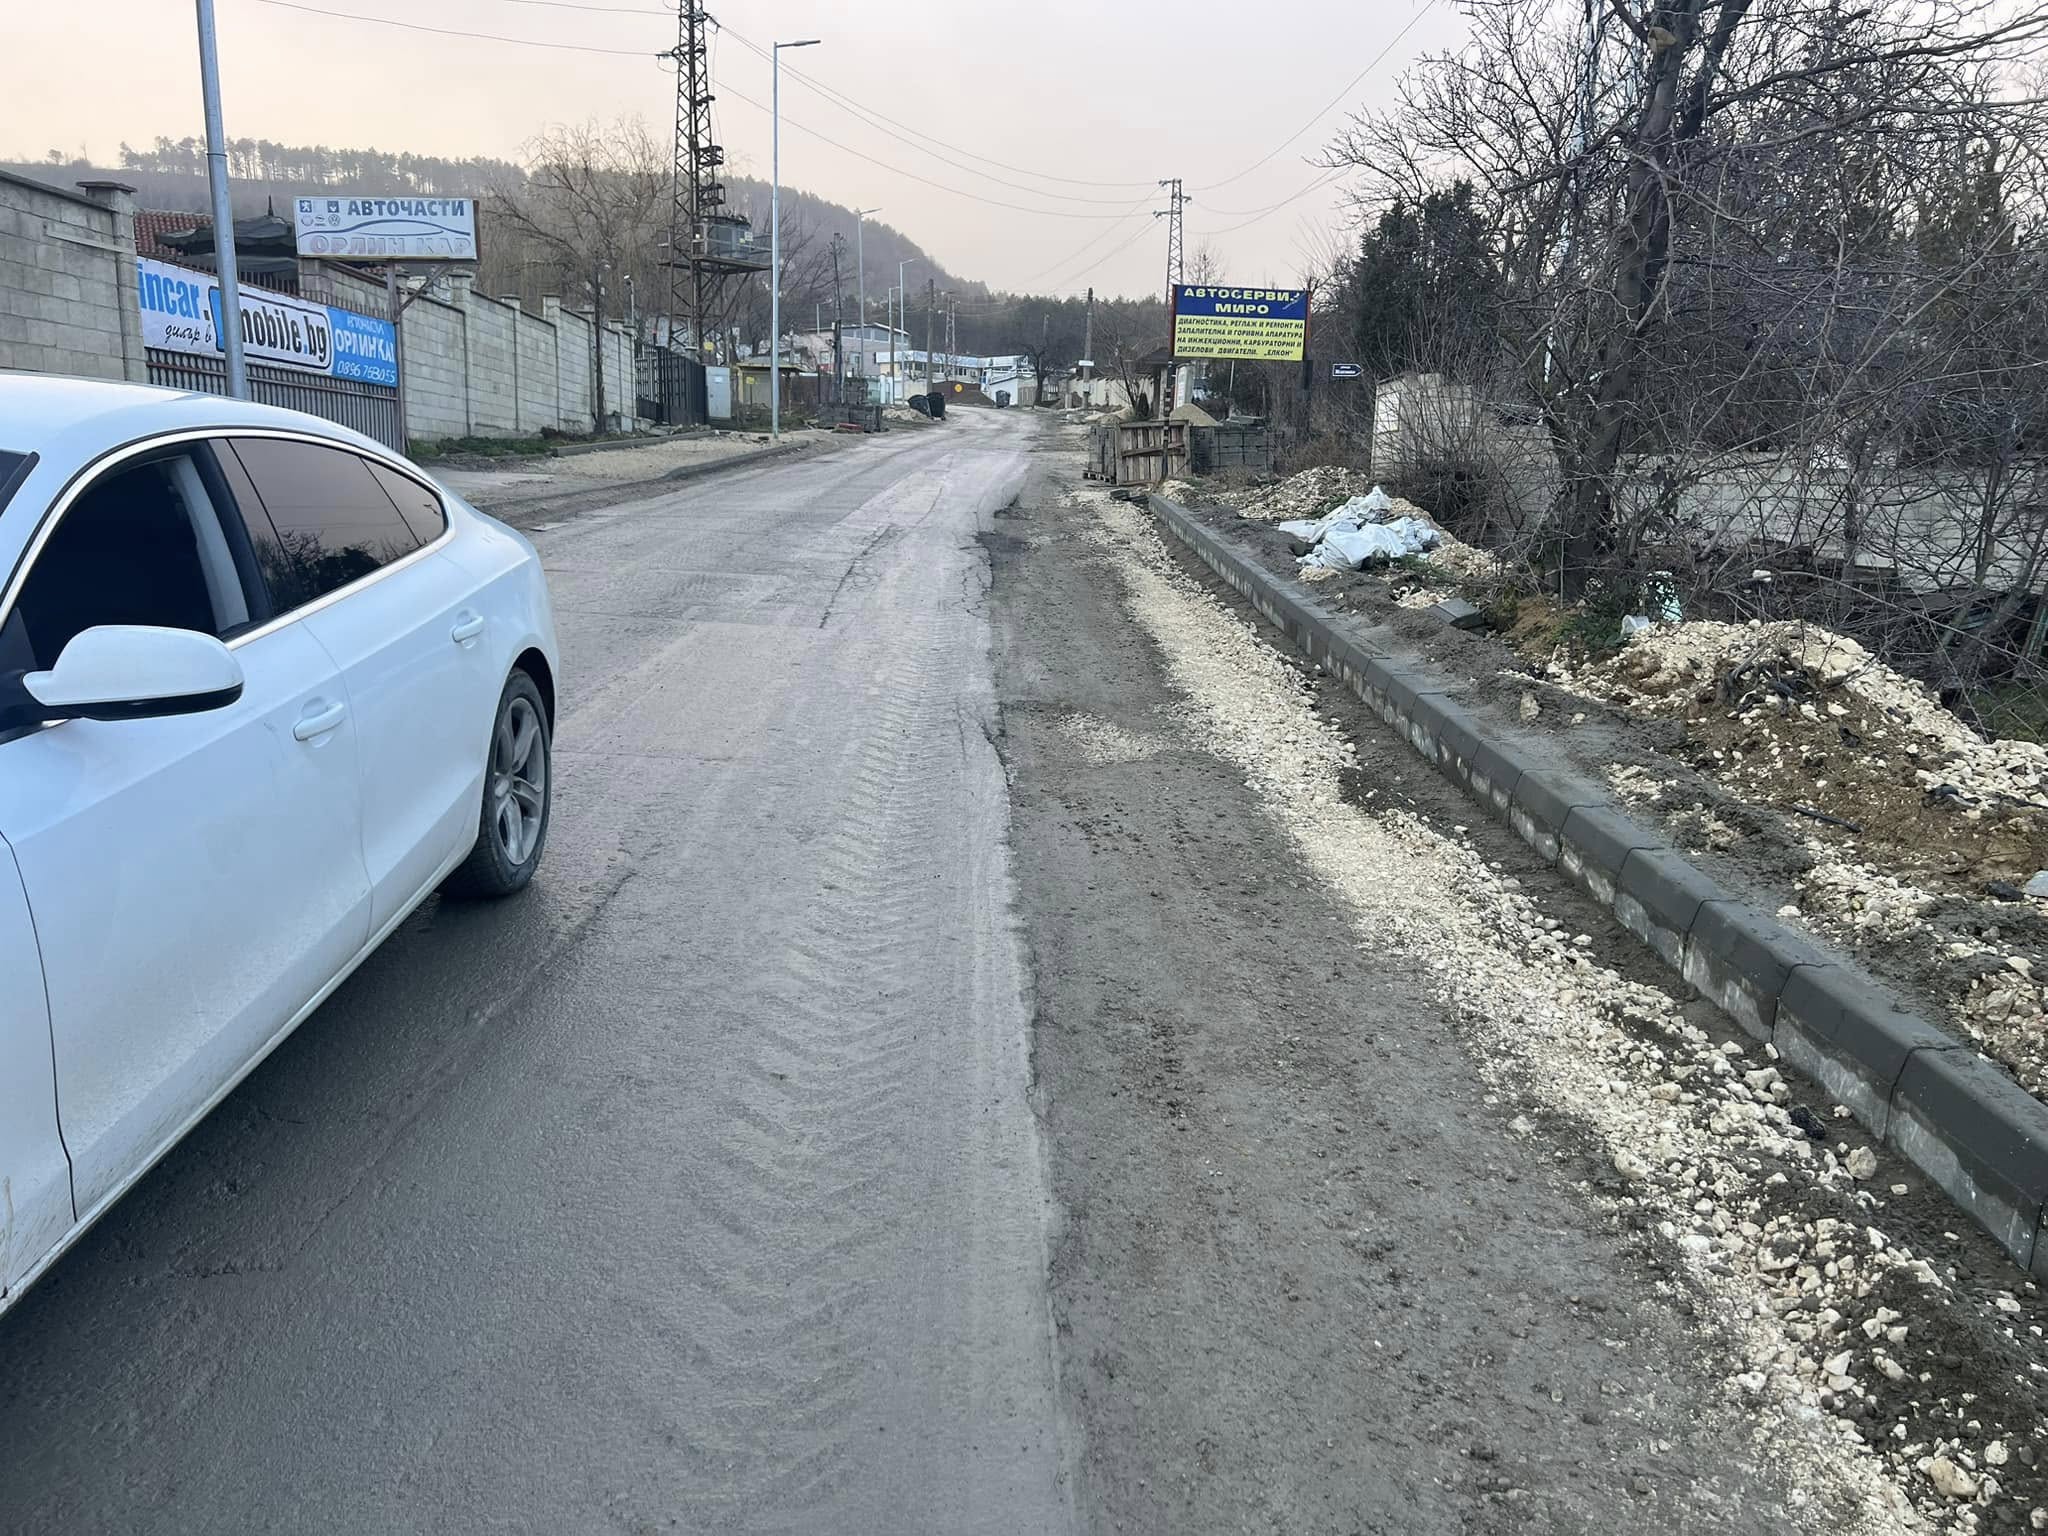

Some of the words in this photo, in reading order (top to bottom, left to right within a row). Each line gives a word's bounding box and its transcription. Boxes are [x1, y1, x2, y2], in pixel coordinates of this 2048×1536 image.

[348, 200, 465, 217] АВТОЧАСТИ
[310, 235, 406, 255] ОРЛИН
[416, 238, 472, 255] КАР
[1215, 303, 1270, 314] МИРО
[1265, 321, 1294, 329] РЕМОНТ
[1177, 327, 1226, 336] ЗАПАЛИТЕЛНА
[1233, 329, 1264, 337] ГОРИВНА
[1265, 330, 1303, 339] АПАРАТУРА
[1243, 339, 1296, 348] КАРБУРАТОРНИ
